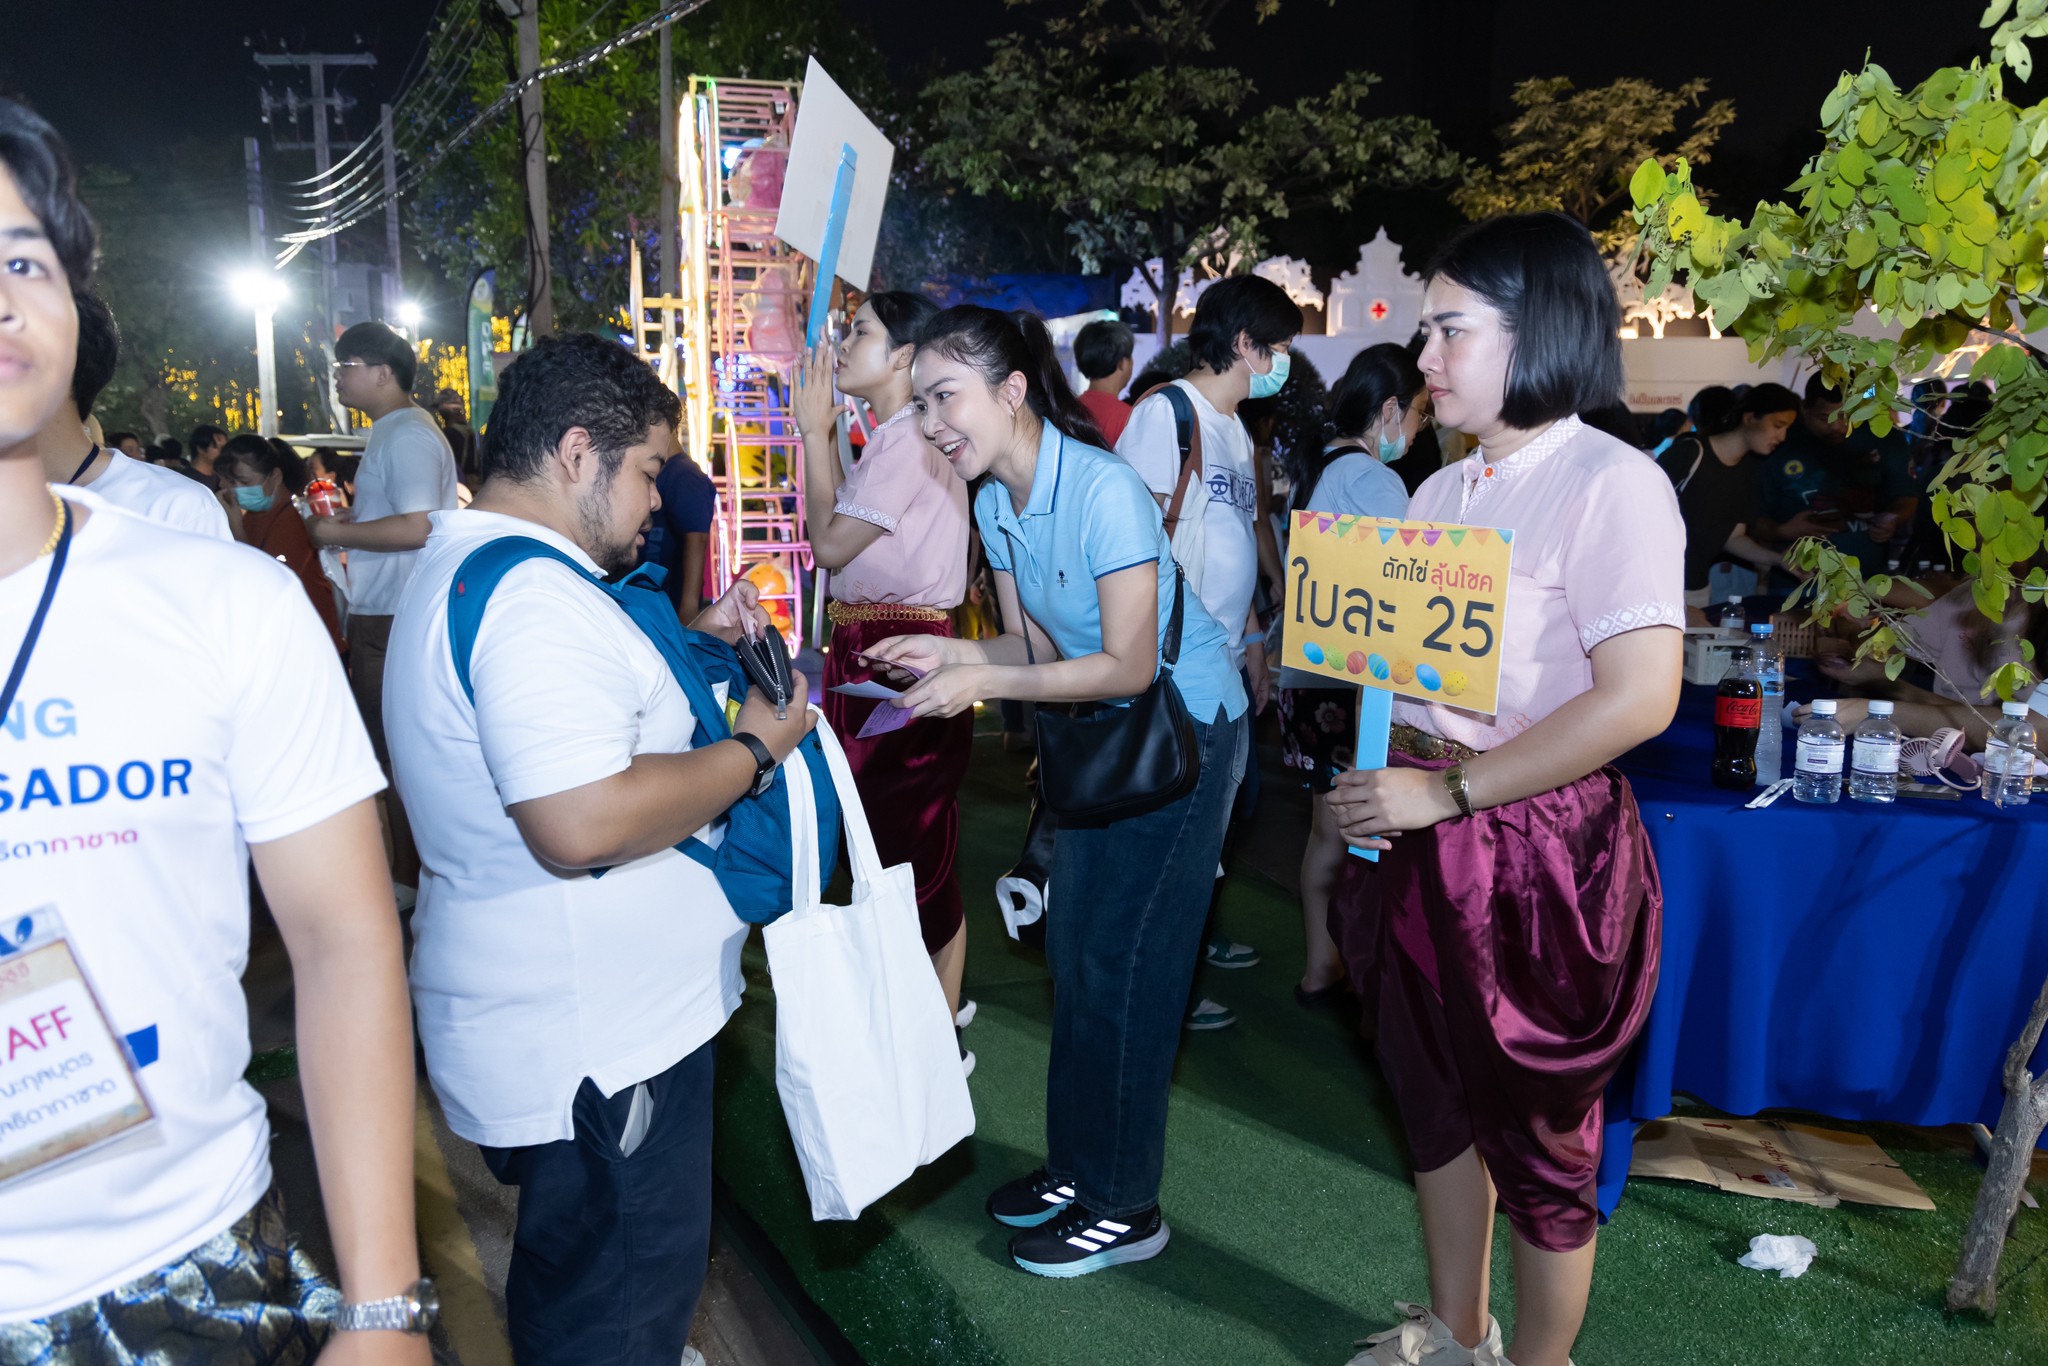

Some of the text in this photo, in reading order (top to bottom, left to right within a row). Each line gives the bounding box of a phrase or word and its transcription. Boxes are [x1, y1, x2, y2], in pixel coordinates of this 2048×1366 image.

[1382, 556, 1493, 593] ตักไข่ ลุ้นโชค
[1291, 556, 1495, 658] ใบละ 25
[0, 1005, 72, 1067] AFF
